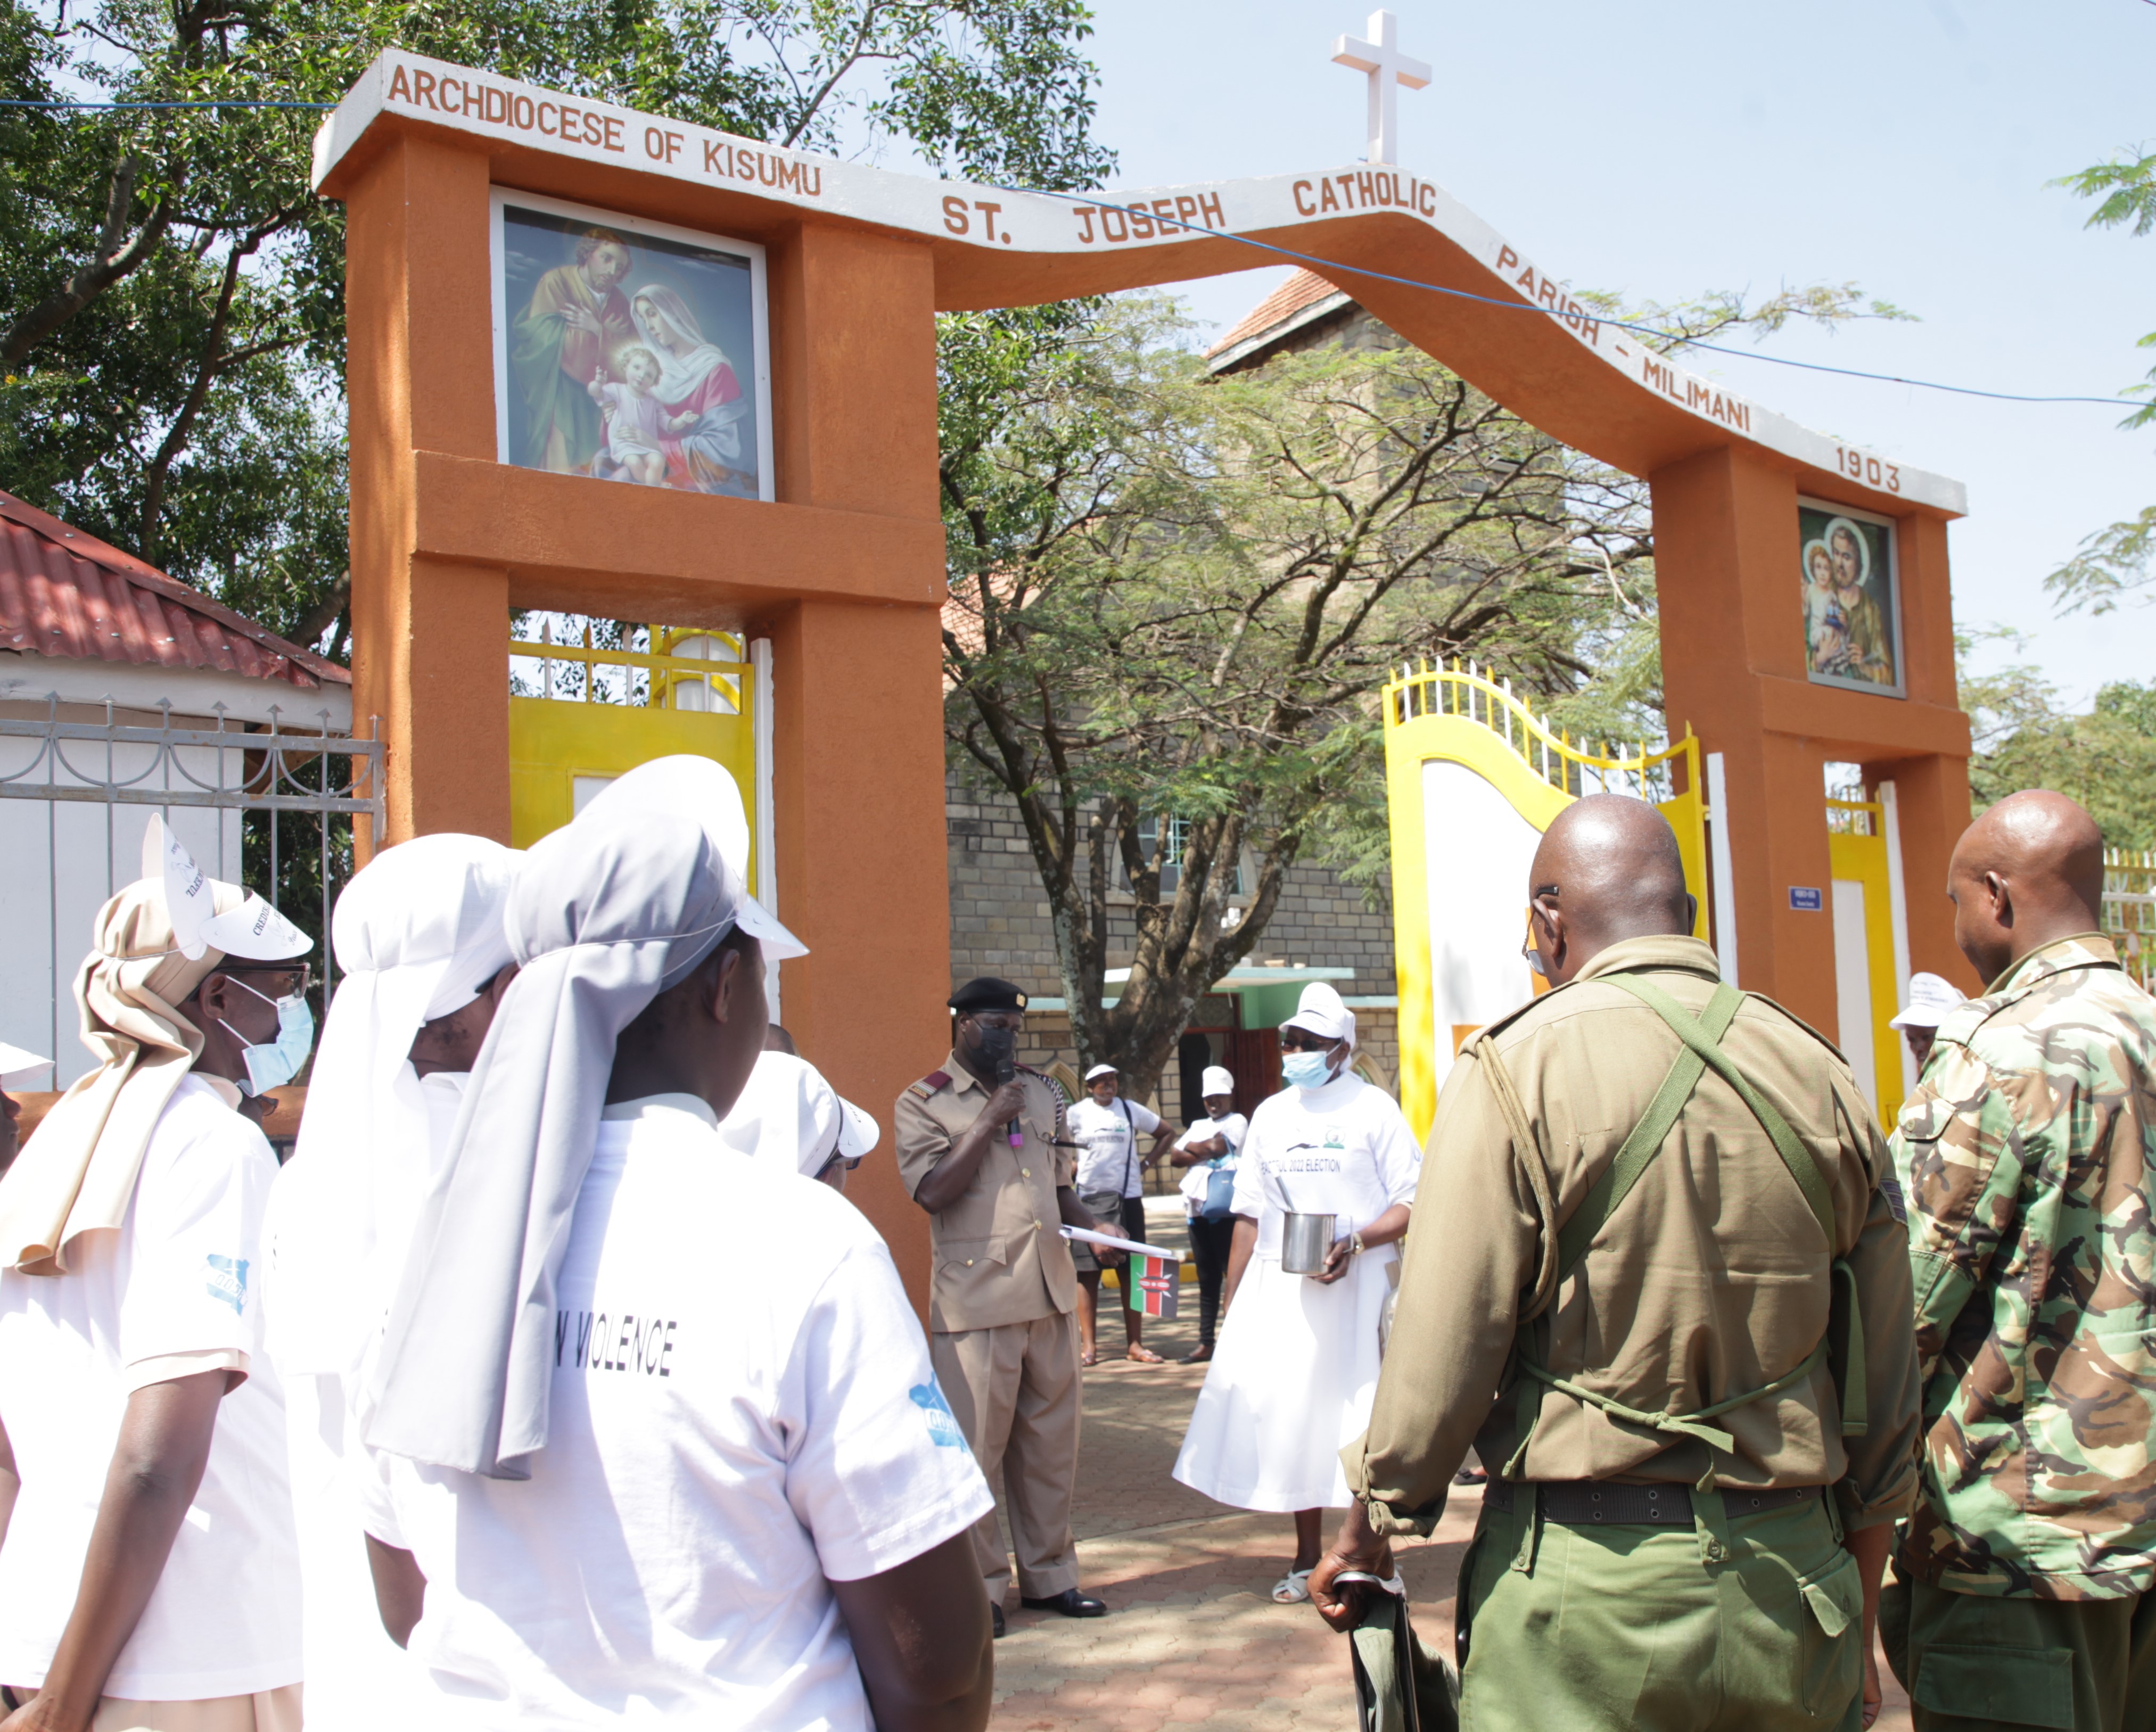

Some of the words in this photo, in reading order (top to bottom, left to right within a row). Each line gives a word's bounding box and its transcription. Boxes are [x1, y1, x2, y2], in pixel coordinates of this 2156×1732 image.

[388, 64, 624, 153] ARCHDIOCESE
[645, 127, 684, 163] OF
[703, 139, 821, 196] KISUMU
[942, 196, 1011, 244] ST.
[1073, 192, 1225, 243] JOSEPH
[1293, 172, 1436, 218] CATHOLIC
[1496, 244, 1600, 347] PARISH
[1643, 356, 1750, 432] MILIMANI
[1837, 447, 1899, 493] 1903
[1289, 1159, 1304, 1173] 2022
[1305, 1158, 1341, 1174] ELECTION
[577, 1311, 677, 1378] VIOLENCE
